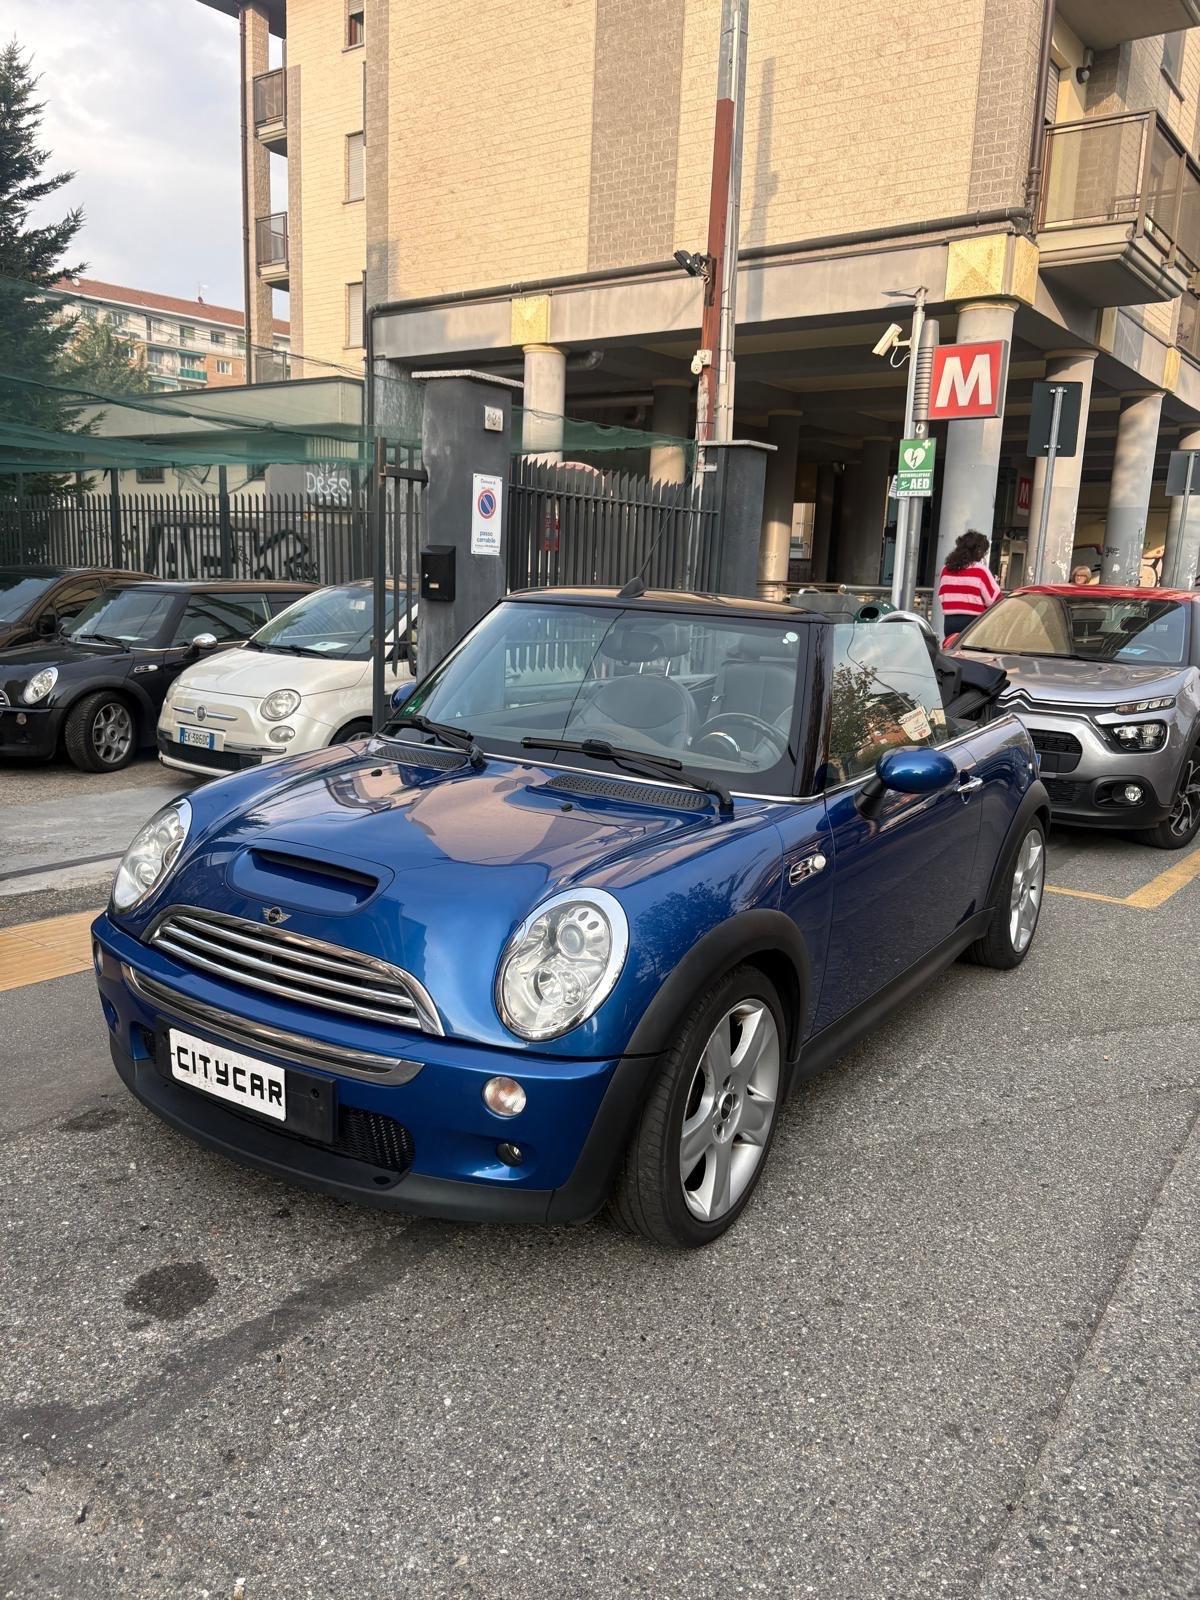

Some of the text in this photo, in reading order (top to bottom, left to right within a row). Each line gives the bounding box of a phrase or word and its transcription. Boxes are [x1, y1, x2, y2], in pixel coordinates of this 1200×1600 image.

[935, 354, 992, 408] M
[909, 478, 930, 490] AED
[176, 1045, 282, 1107] CITYCAR
